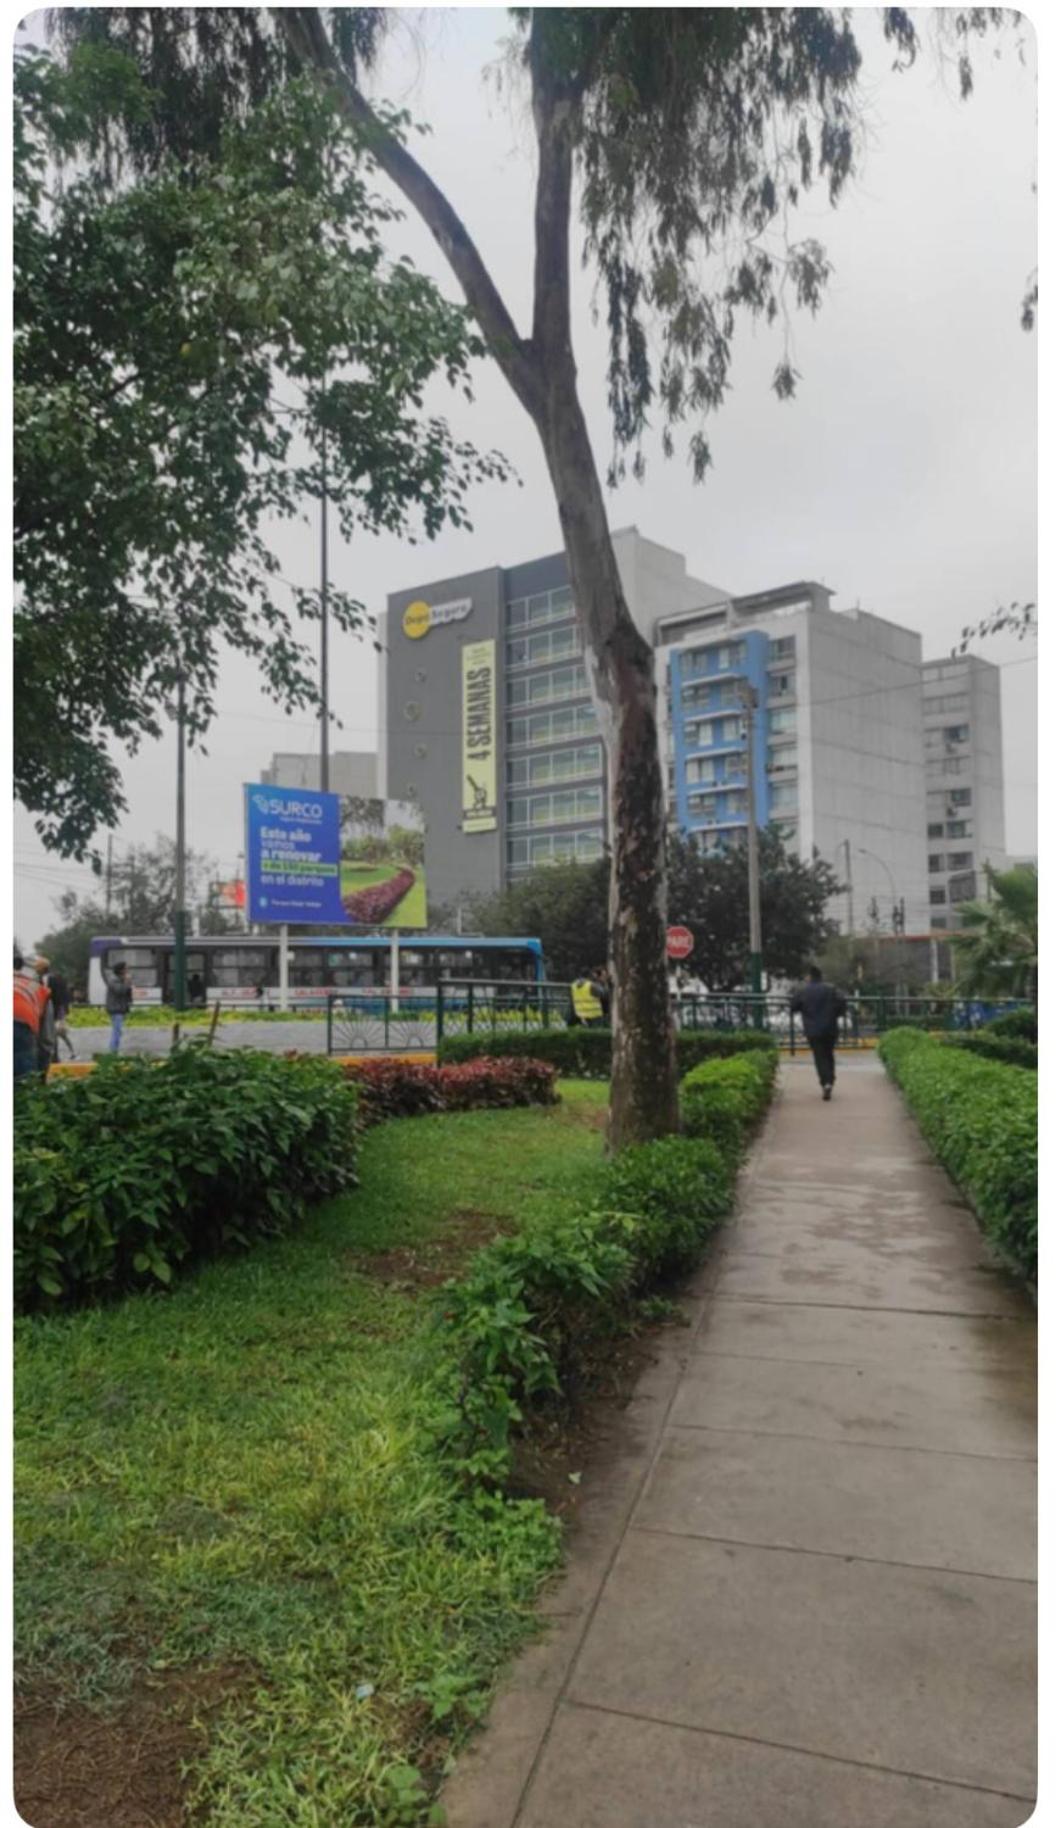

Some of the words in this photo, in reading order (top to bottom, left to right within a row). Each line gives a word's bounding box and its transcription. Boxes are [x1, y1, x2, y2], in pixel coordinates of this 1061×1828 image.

[466, 667, 491, 748] SEMANAS
[466, 749, 491, 761] 4
[270, 799, 322, 818] SURCO
[260, 826, 287, 840] Este
[289, 828, 312, 842] año
[271, 850, 322, 863] renovar
[260, 875, 274, 885] en
[275, 875, 286, 885] el
[287, 875, 325, 887] distrito
